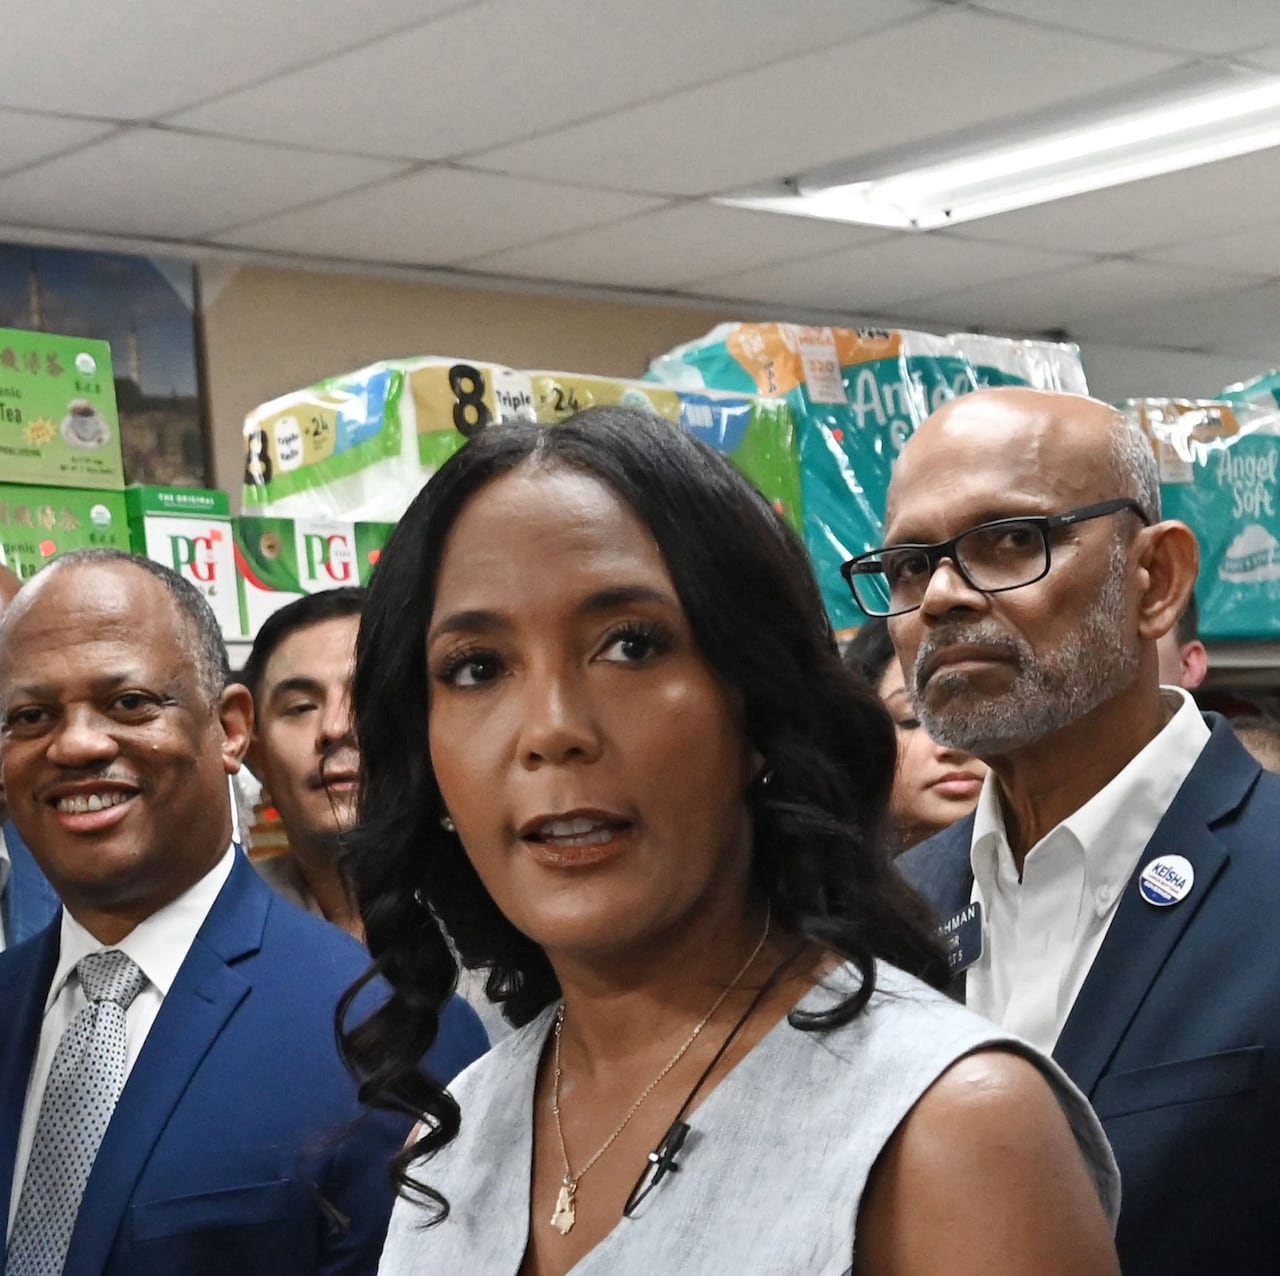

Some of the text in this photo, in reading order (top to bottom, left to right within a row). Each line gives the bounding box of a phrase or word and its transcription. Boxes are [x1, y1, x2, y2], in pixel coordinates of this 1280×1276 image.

[449, 364, 489, 437] 8
[495, 390, 531, 411] Triple
[1217, 448, 1278, 487] Angel
[1232, 480, 1276, 519] Soft
[168, 535, 217, 582] PG
[304, 534, 352, 581] PG
[1151, 863, 1187, 890] KEISHA
